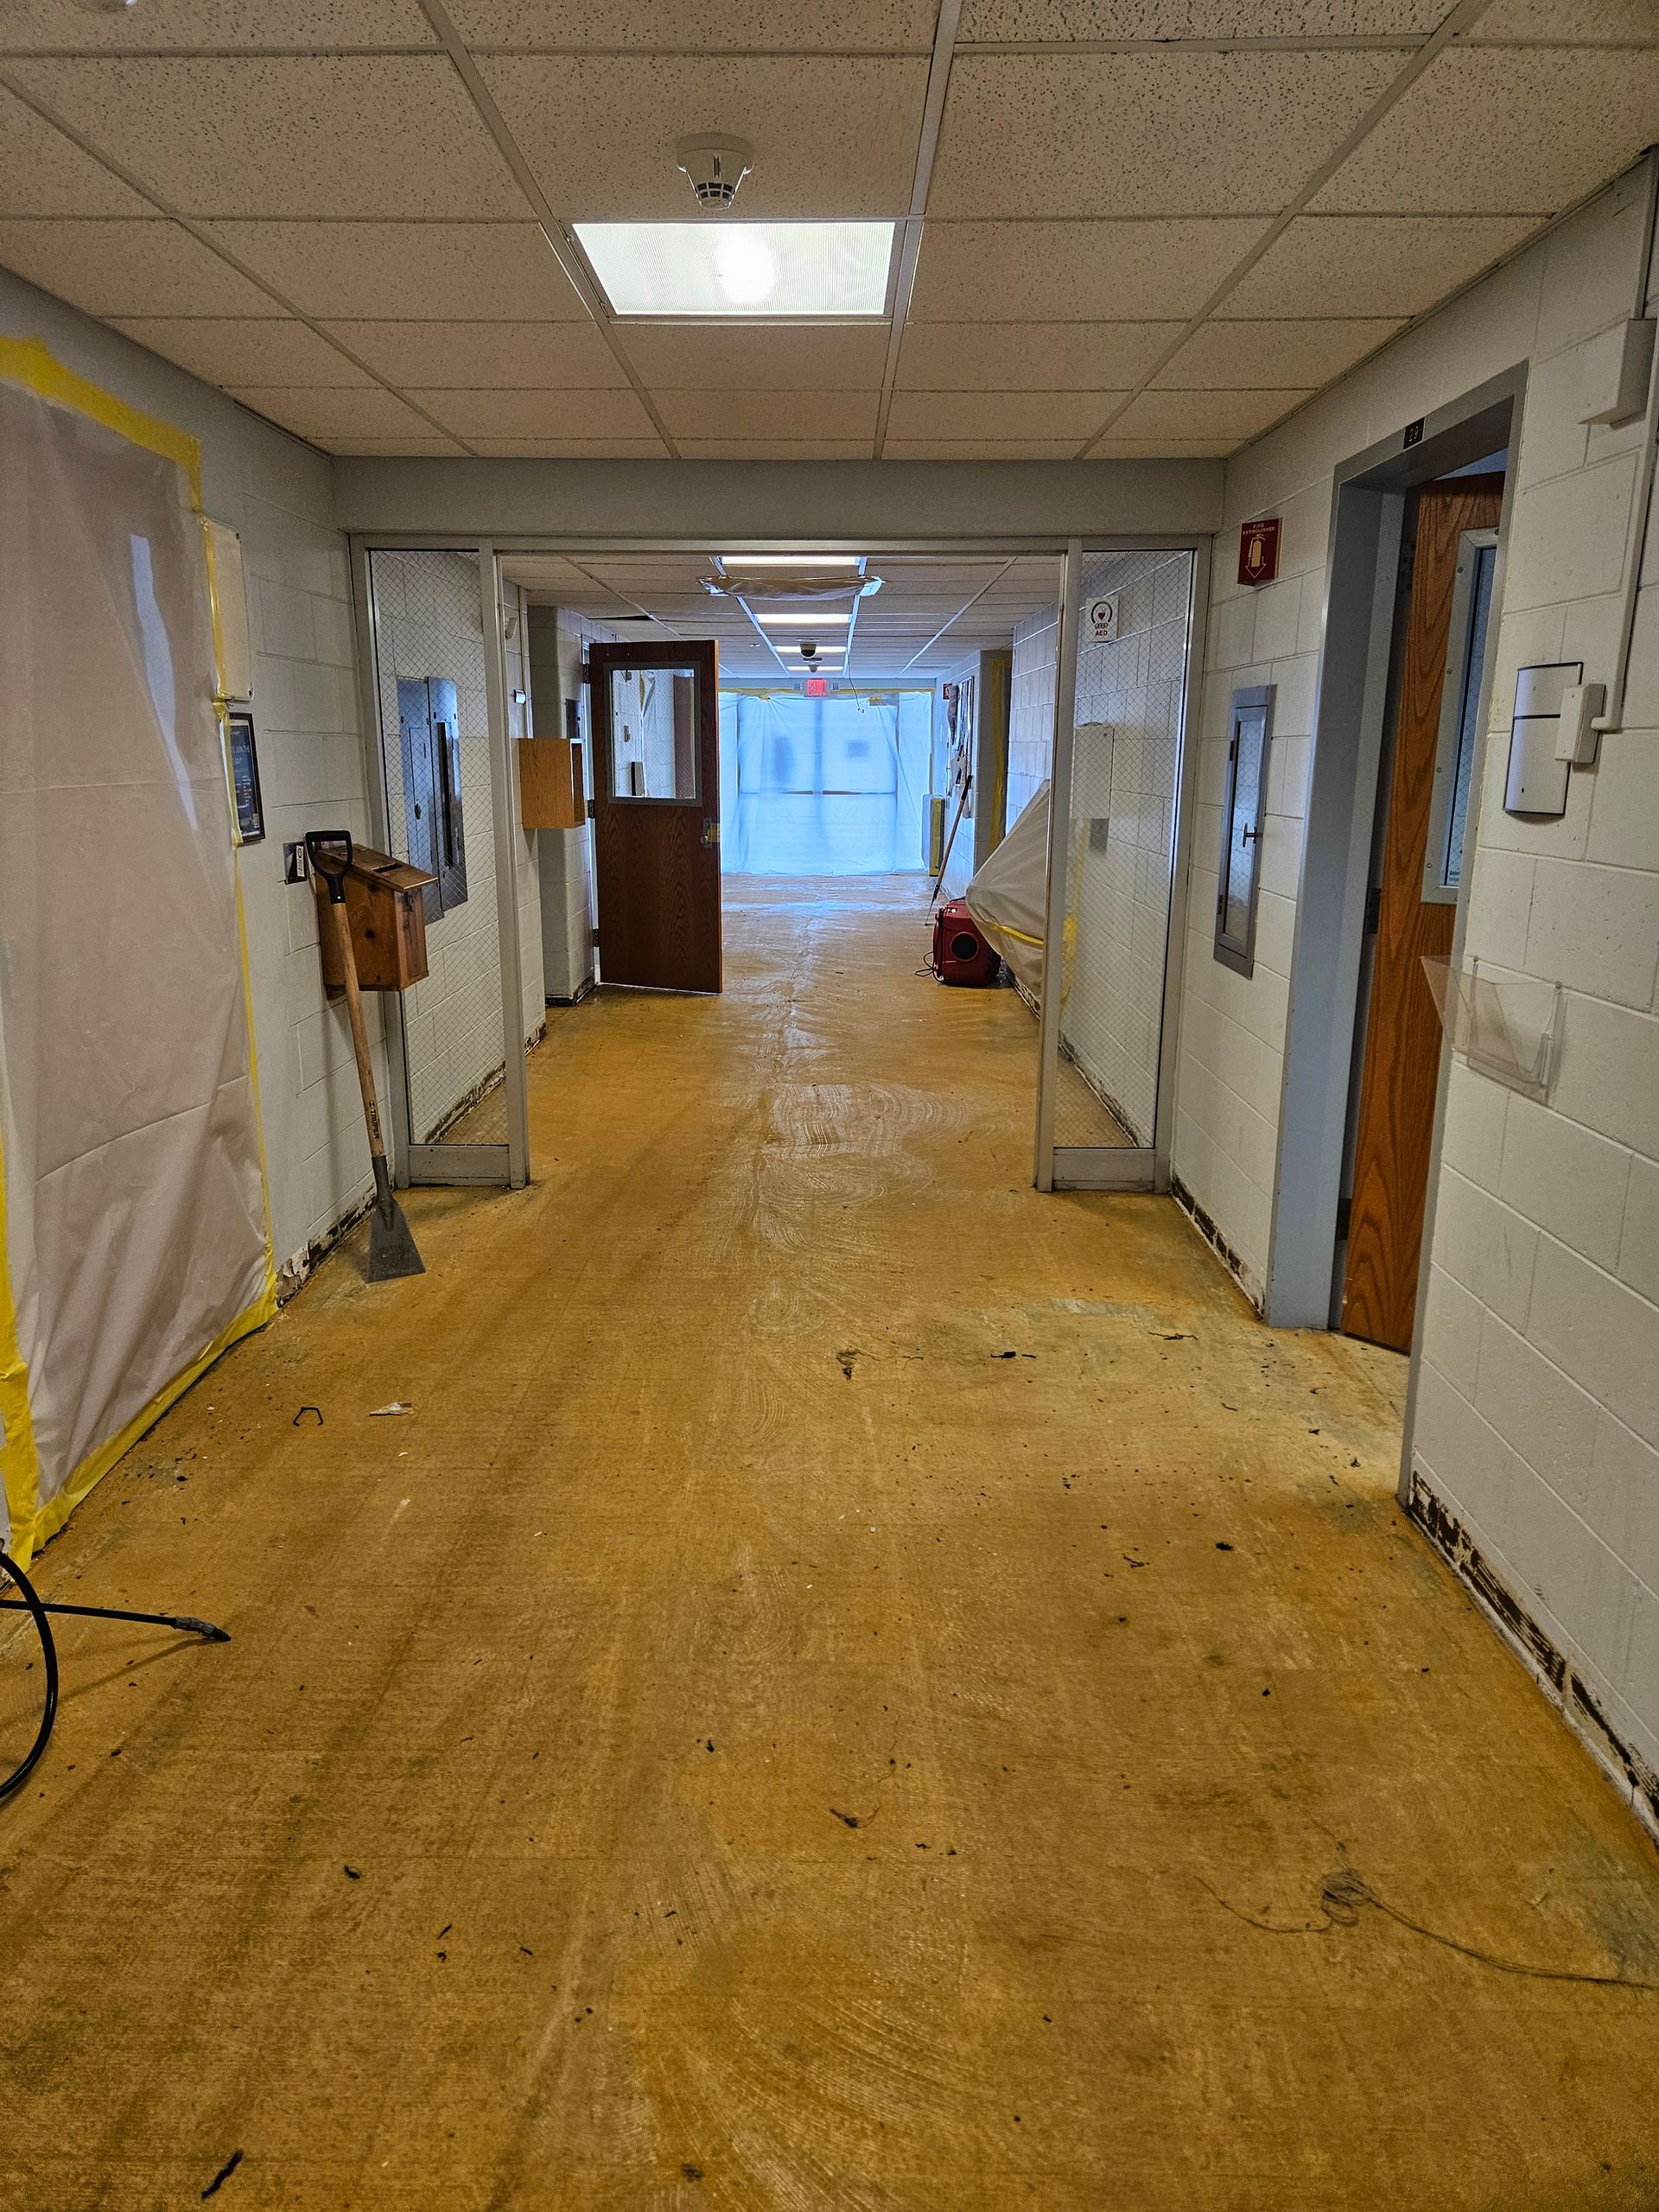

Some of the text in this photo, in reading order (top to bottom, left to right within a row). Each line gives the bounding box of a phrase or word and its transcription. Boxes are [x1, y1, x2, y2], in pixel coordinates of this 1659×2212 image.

[1408, 426, 1419, 442] 29
[1243, 526, 1275, 535] EXTINGUISHER
[807, 679, 827, 696] EXIT
[371, 1109, 380, 1139] TRUPER
